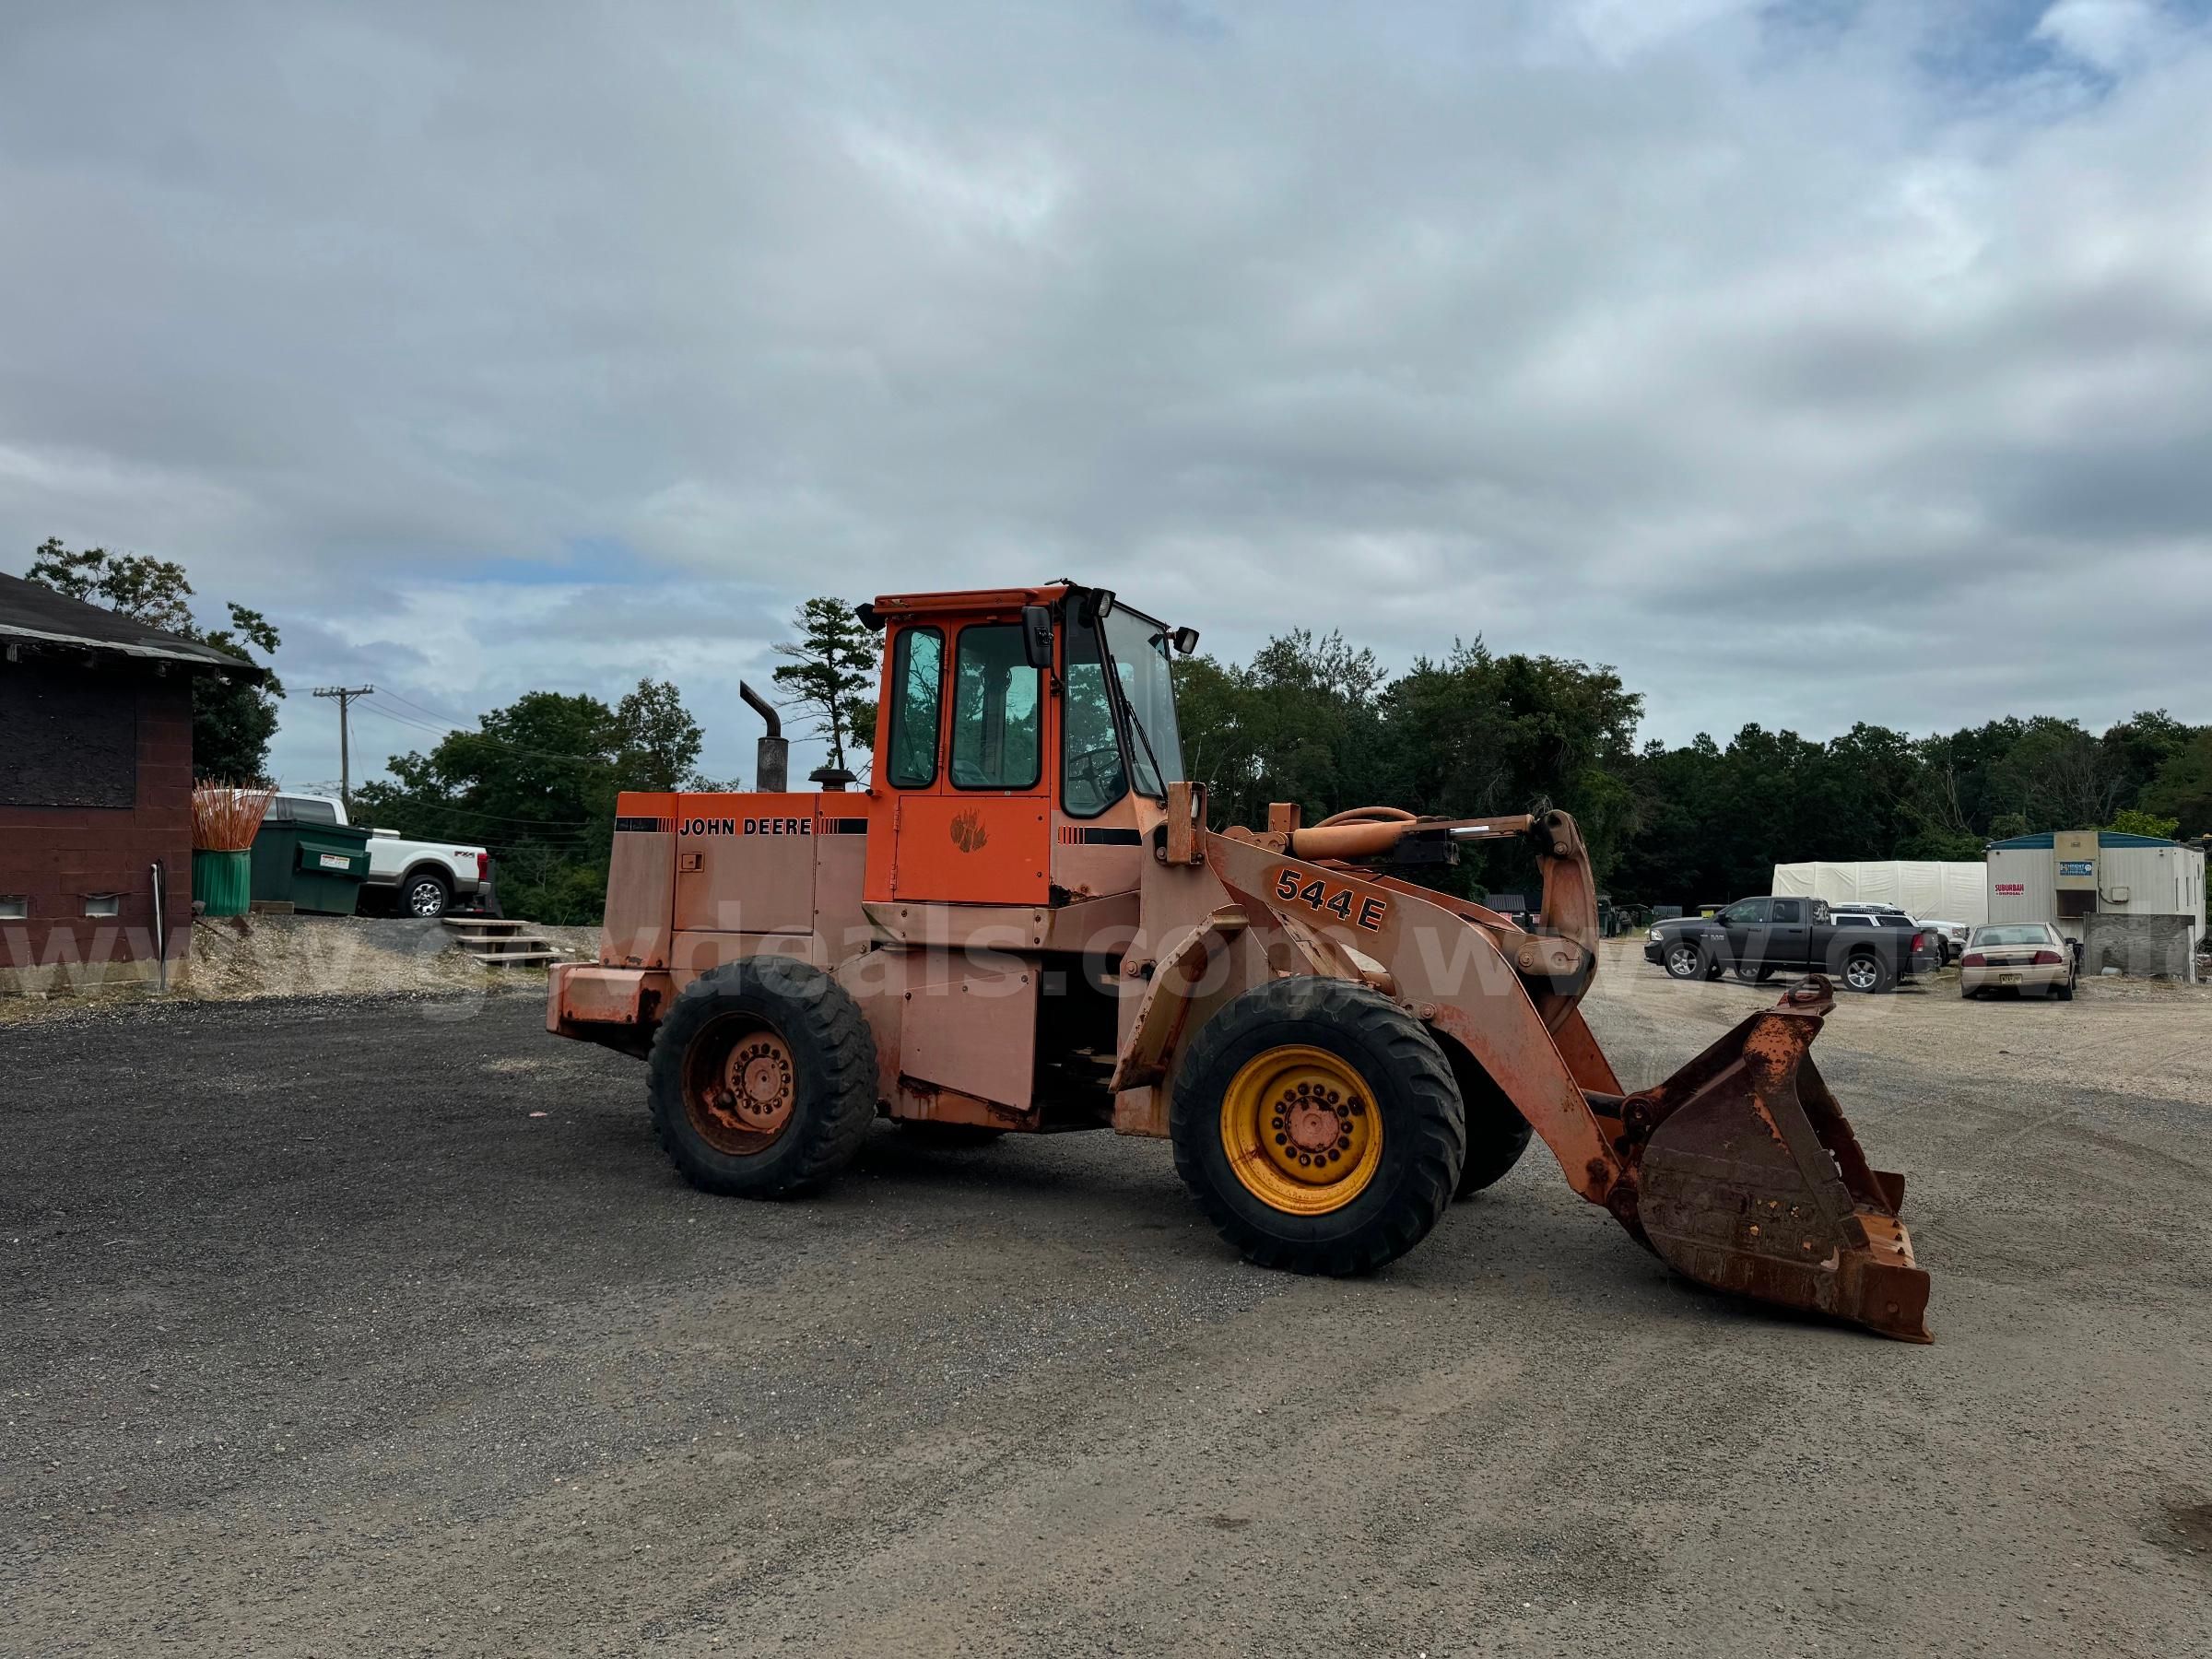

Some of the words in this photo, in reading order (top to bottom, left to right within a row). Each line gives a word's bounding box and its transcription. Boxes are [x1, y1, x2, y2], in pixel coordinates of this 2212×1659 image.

[679, 818, 735, 836] JOHN
[743, 817, 813, 836] DEERE
[1994, 883, 2025, 892] SUBURBAN
[1276, 868, 1387, 933] 544E
